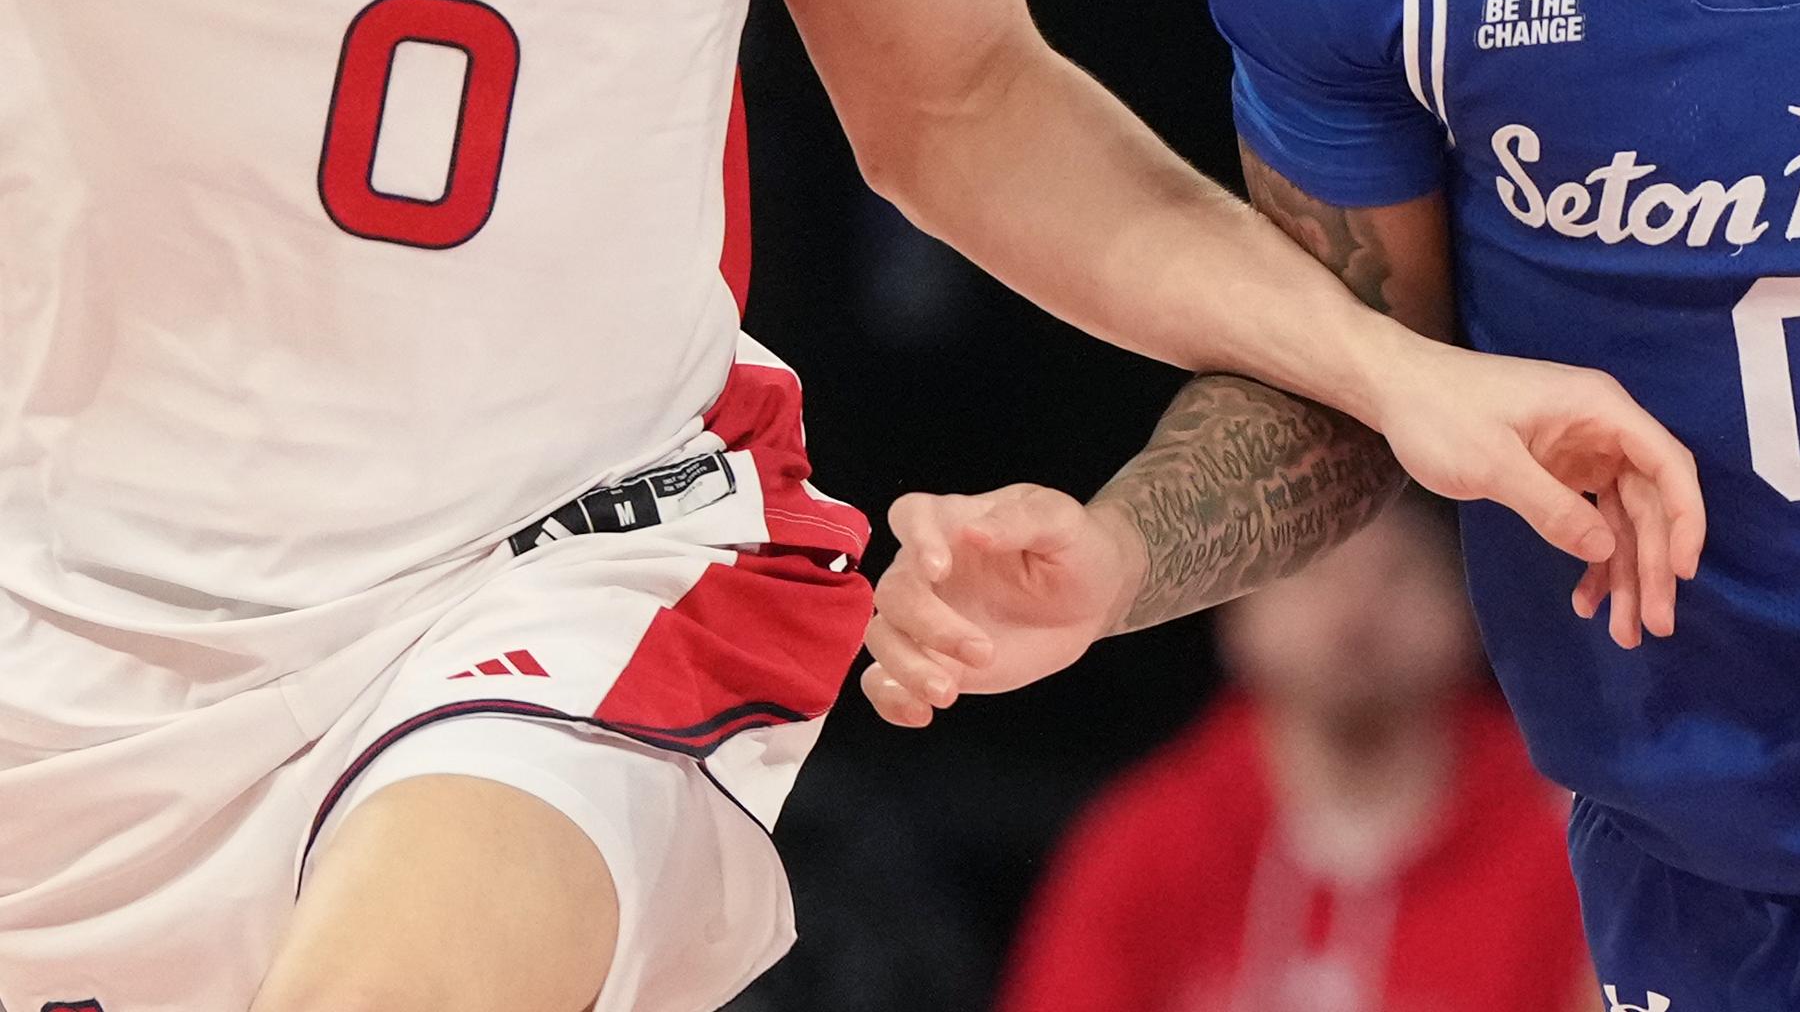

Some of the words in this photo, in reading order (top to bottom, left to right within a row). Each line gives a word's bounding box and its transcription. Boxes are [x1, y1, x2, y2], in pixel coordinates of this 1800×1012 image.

[1477, 16, 1583, 50] CHANGE
[1490, 123, 1768, 248] Seton
[614, 500, 636, 527] M
